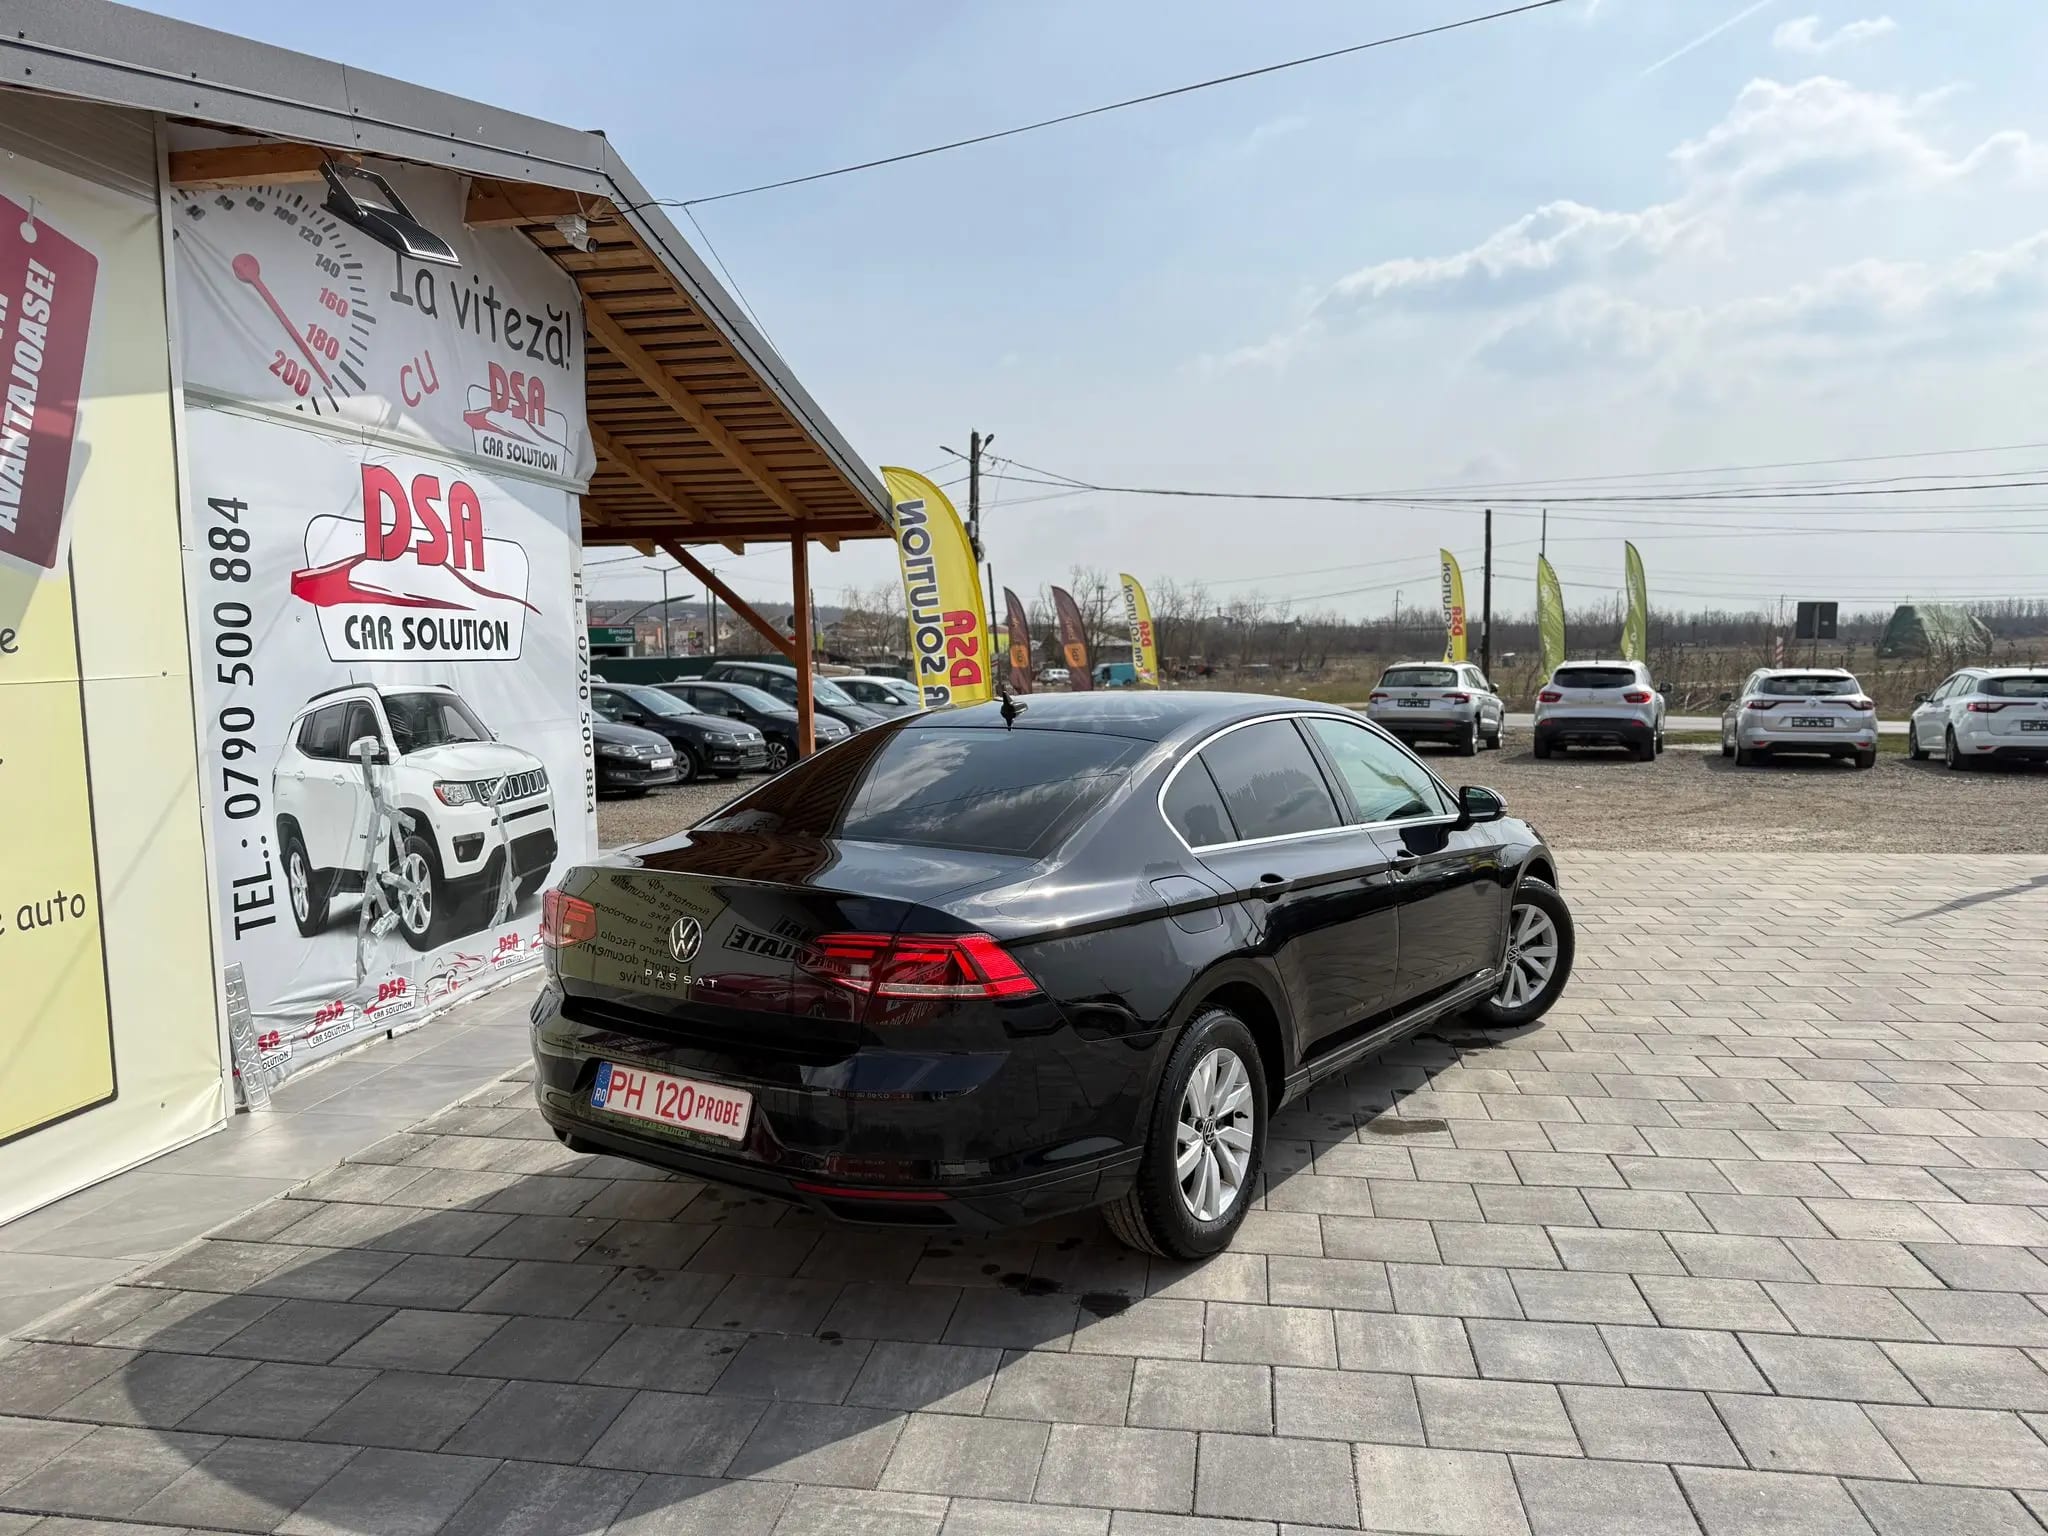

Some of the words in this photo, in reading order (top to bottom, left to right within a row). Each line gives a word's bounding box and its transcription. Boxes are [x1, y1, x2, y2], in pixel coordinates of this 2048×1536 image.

[273, 205, 299, 226] 100
[298, 225, 323, 248] 120
[314, 253, 341, 279] 140
[318, 287, 349, 318] 160
[450, 274, 572, 371] viteză!
[305, 323, 341, 361] 180
[268, 349, 312, 397] 200
[400, 350, 440, 408] cu
[0, 258, 56, 534] AVANTAJOASE!
[488, 361, 546, 427] DSA
[482, 435, 504, 459] CAR
[506, 443, 558, 472] SOLUTION
[361, 463, 485, 572] DSA
[207, 496, 252, 583] 884
[213, 601, 254, 687] 500
[344, 614, 394, 651] CAR
[402, 617, 509, 651] SOLUTION
[578, 635, 589, 701] 0790
[580, 711, 593, 759] 500
[218, 705, 262, 820] 0790
[585, 767, 595, 815] 884
[232, 833, 278, 941] TEL.:
[16, 890, 86, 932] auto
[498, 932, 519, 952] DSA
[378, 977, 407, 1001] DSA
[645, 968, 718, 988] PASSAT
[315, 1000, 345, 1026] DSA
[373, 1009, 385, 1020] CAR
[385, 1001, 412, 1017] SOLUTION
[257, 1030, 281, 1053] SA
[312, 1034, 323, 1045] CAR
[323, 1023, 351, 1041] SOLUTION
[262, 1050, 290, 1071] OLUTION
[594, 1087, 607, 1102] RO
[606, 1070, 647, 1110] PH
[654, 1079, 696, 1121] 120
[695, 1094, 743, 1127] PROBE
